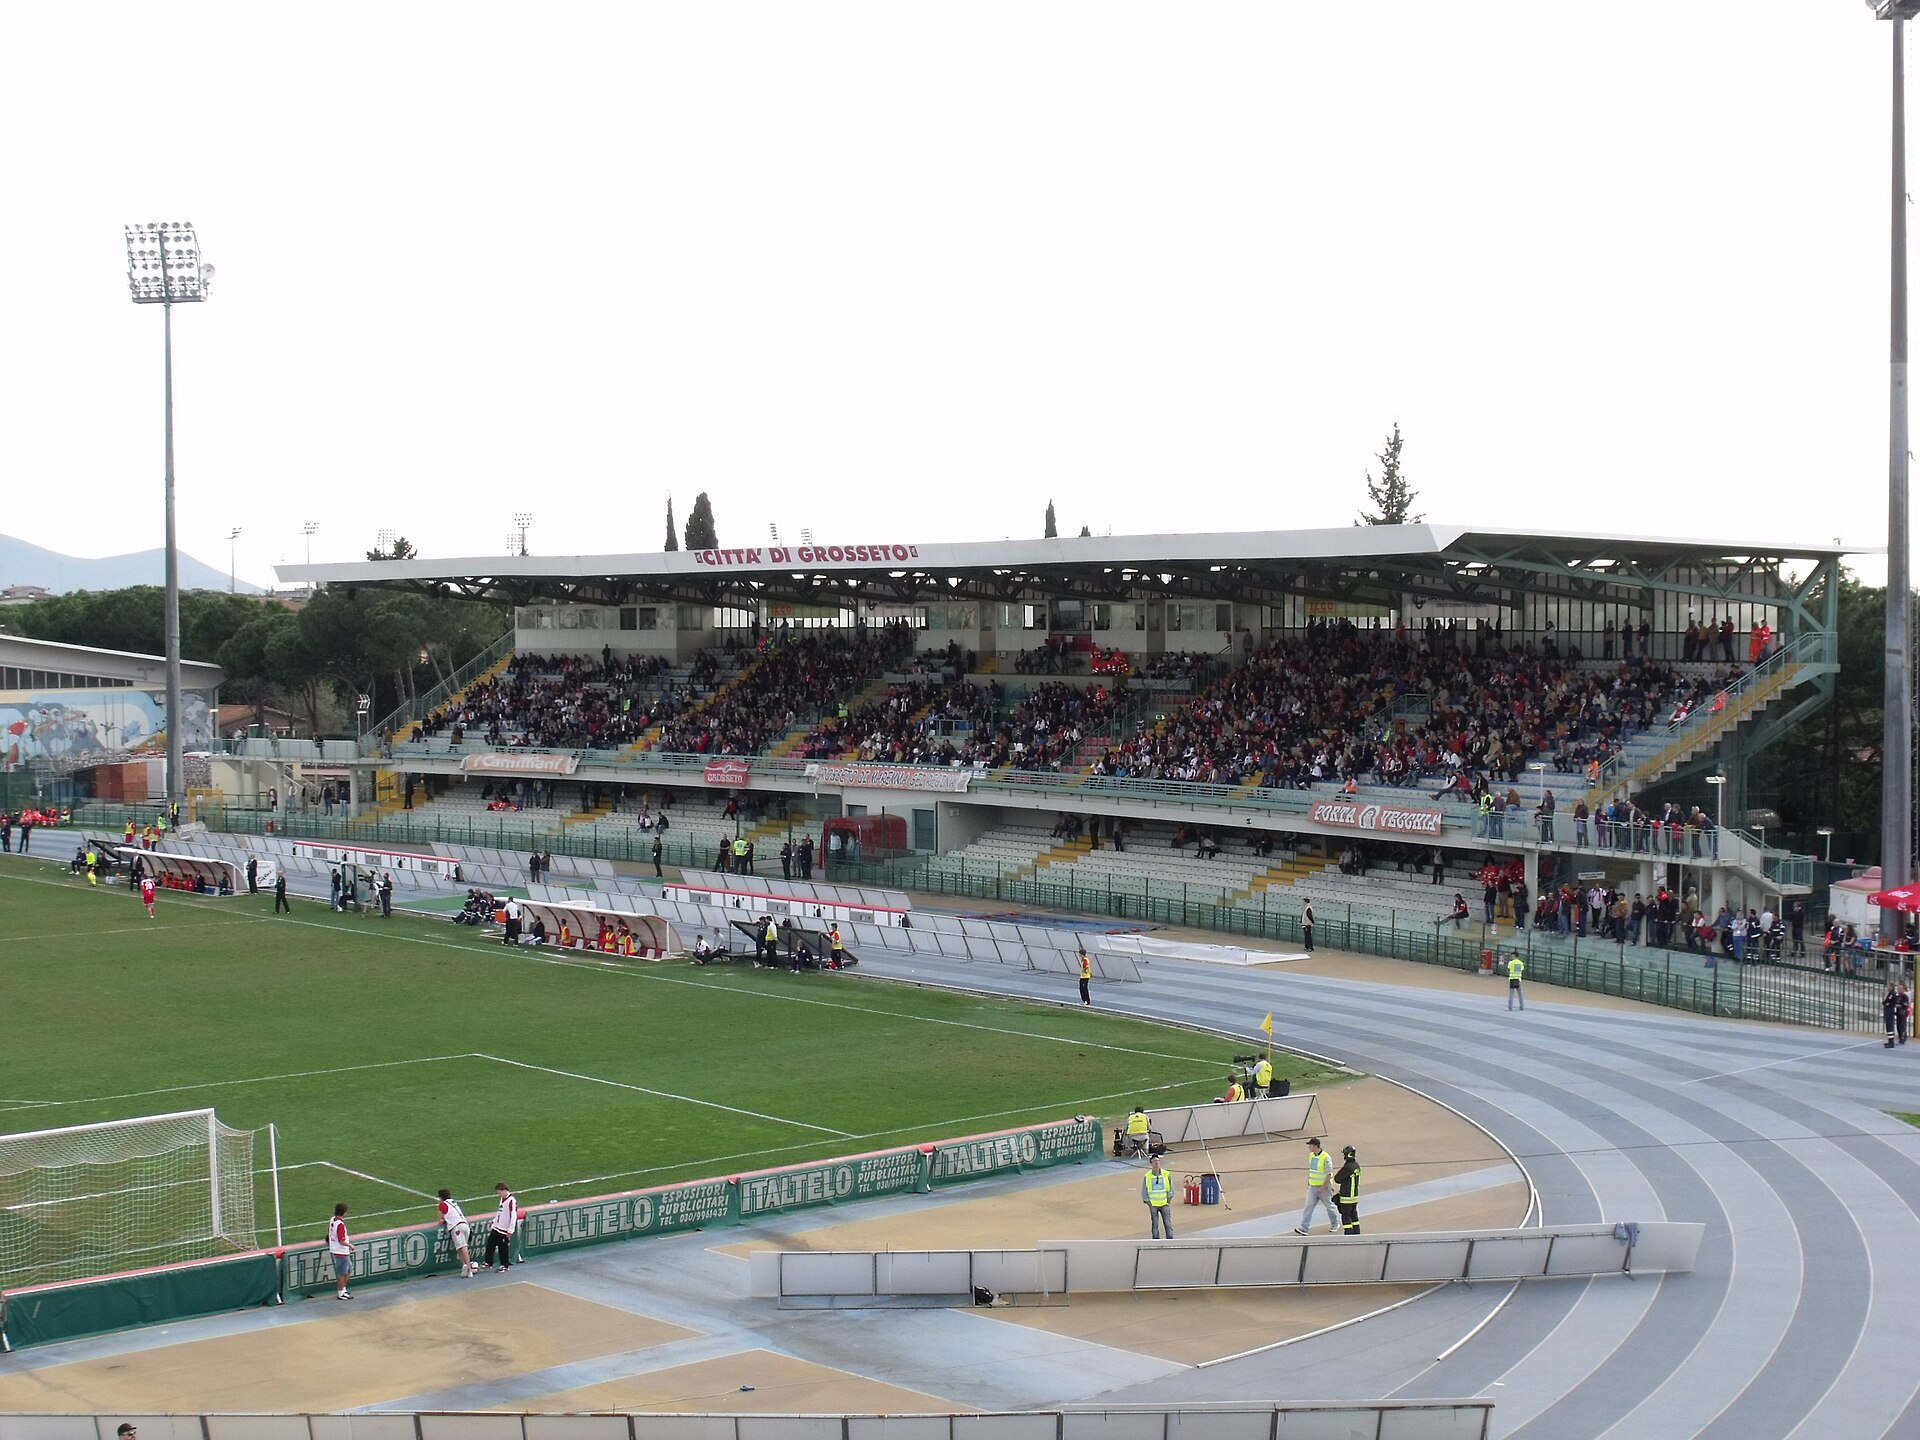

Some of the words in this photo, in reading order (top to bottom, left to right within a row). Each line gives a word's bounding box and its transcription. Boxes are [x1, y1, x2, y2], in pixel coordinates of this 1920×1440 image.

[703, 548, 762, 565] CITTA'
[769, 547, 792, 563] DI
[798, 544, 908, 563] GROSSETO
[707, 773, 743, 784] GROSSETO
[1314, 805, 1357, 824] PORTA
[1381, 810, 1440, 831] VECCHIA
[1041, 1121, 1093, 1140] ESPOSITORI
[1040, 1132, 1096, 1151] PUBBLICITARI
[861, 1152, 917, 1172] ESPOSITORI
[936, 1131, 1037, 1178] ITALTELO
[1041, 1151, 1053, 1160] TEL.
[857, 1163, 921, 1184] PUBBLICITARI
[662, 1183, 726, 1204] ESPOSITORI
[741, 1164, 854, 1214] ITALTELO
[859, 1183, 872, 1193] TEL.
[658, 1195, 729, 1217] PUBBLICITARI
[526, 1196, 654, 1248] ITALTELO
[660, 1216, 675, 1227] TEL.
[435, 1253, 452, 1264] TEL.
